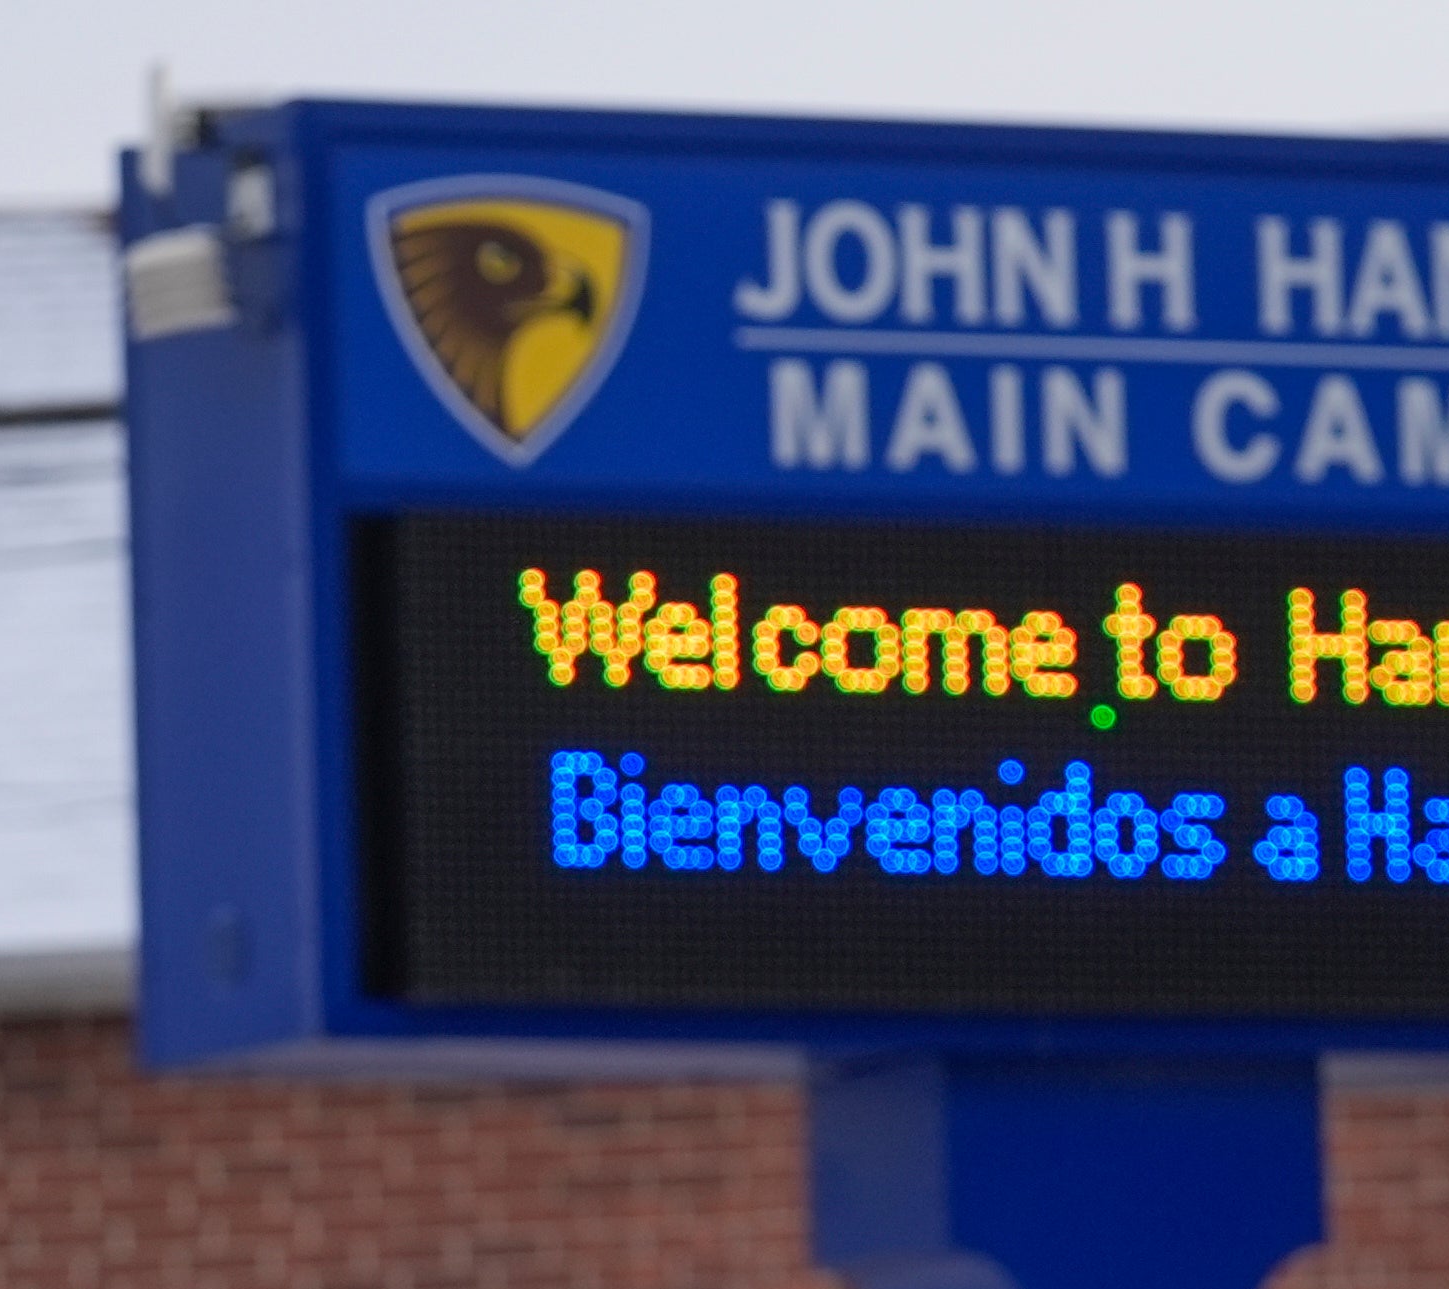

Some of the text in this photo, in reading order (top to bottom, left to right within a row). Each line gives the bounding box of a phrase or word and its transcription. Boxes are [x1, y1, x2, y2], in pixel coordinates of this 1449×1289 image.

[735, 199, 1077, 329] JOHN
[1106, 211, 1195, 332] H
[769, 358, 1128, 477] MAIN
[520, 568, 1076, 697] Welcome
[1104, 583, 1236, 700] to
[551, 751, 1226, 878] Bienvenidos
[1253, 795, 1319, 881] a
